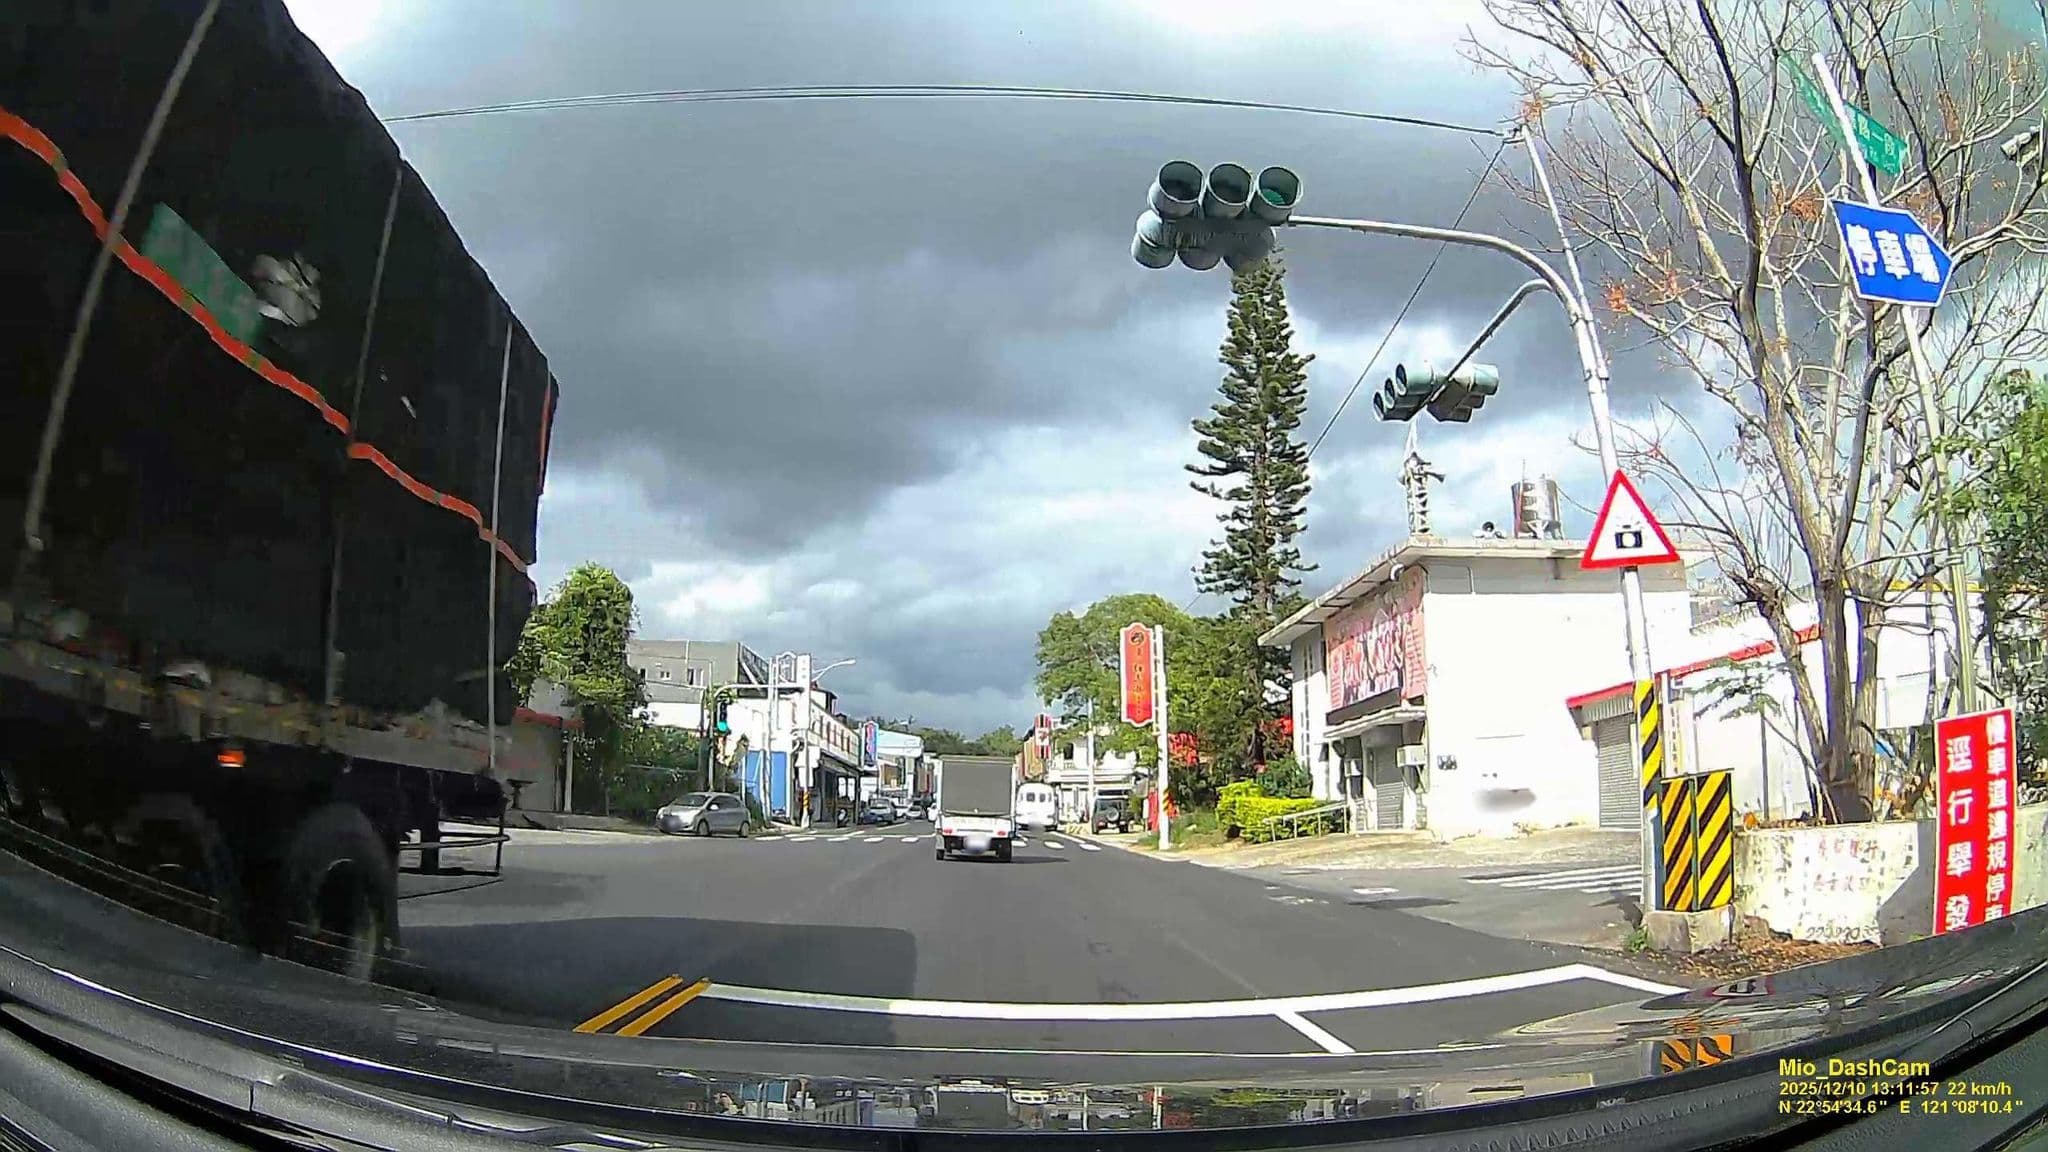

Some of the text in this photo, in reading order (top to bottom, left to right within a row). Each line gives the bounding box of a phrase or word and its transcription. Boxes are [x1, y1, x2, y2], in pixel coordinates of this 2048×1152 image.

[1846, 223, 1941, 283] 停車場
[1945, 735, 1975, 931] 逕行舉發
